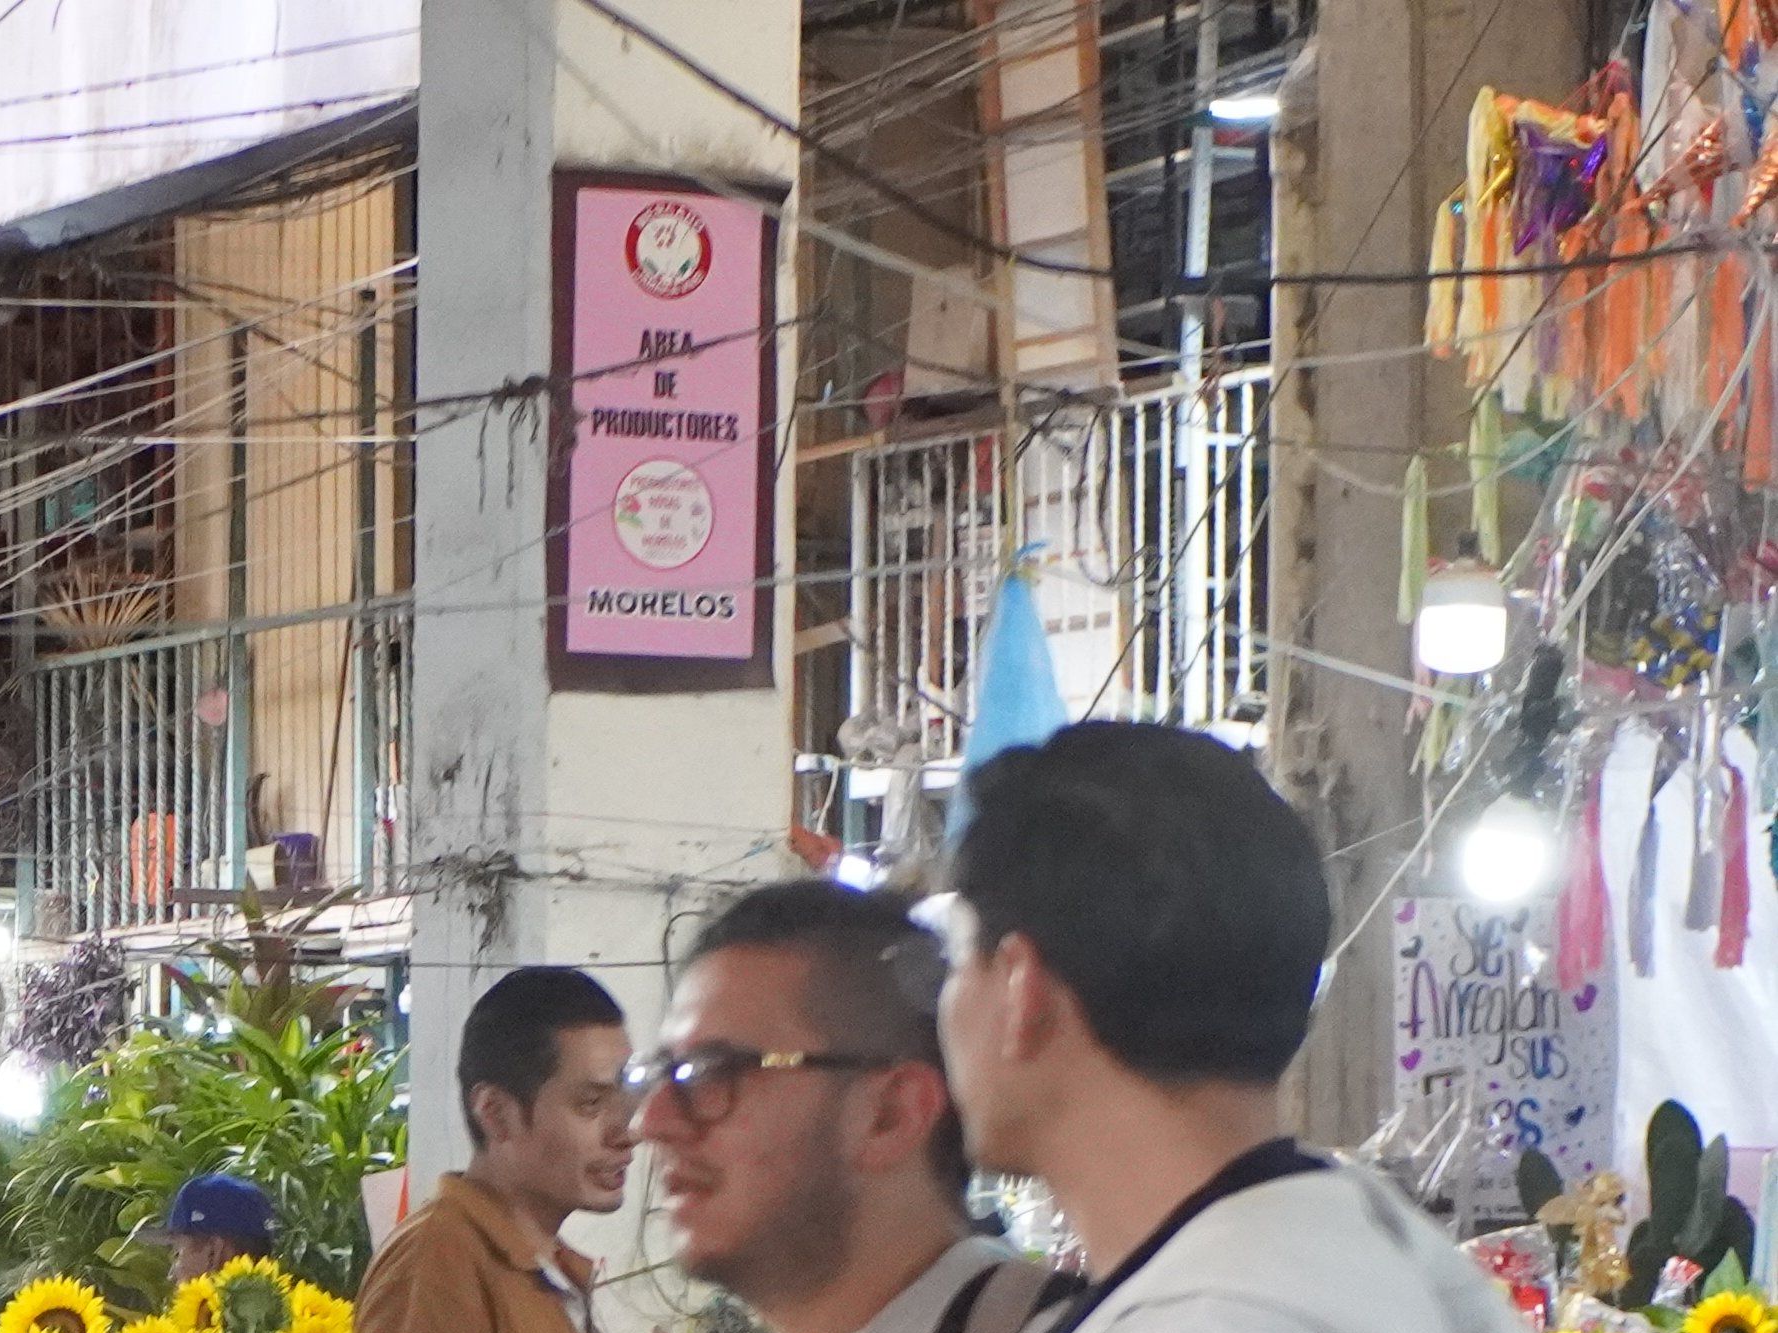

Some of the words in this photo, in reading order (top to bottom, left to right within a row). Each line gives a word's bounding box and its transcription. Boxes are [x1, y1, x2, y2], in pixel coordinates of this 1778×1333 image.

[638, 329, 695, 361] AREA
[654, 371, 677, 399] DE
[591, 407, 739, 441] PRODUCTORES
[587, 589, 735, 618] MORELOS
